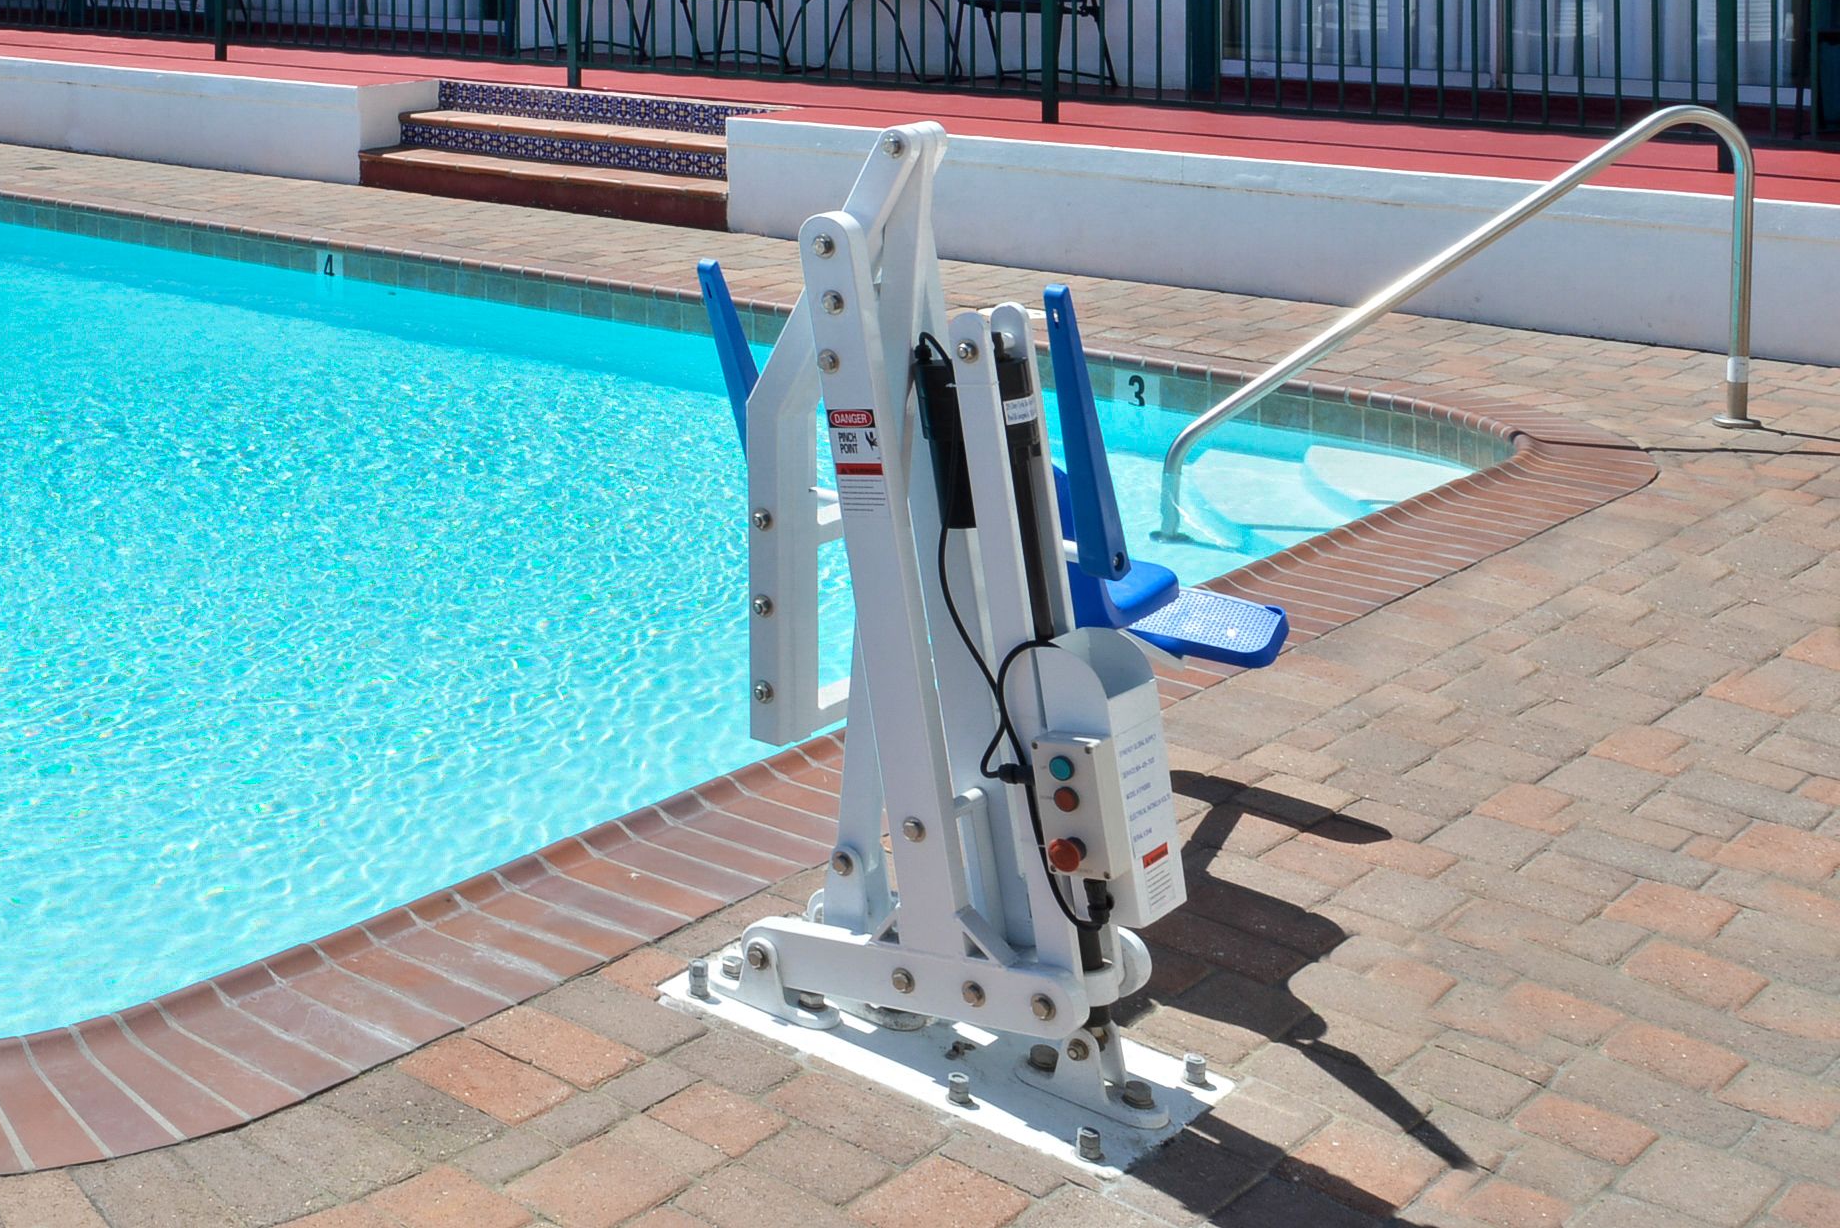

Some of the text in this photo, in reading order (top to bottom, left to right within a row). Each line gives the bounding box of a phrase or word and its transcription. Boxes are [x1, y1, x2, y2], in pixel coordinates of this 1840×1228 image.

[323, 254, 335, 276] 4
[1128, 374, 1145, 406] 3
[834, 414, 868, 424] DANGER
[838, 432, 857, 443] PINCH
[840, 444, 858, 454] POINT
